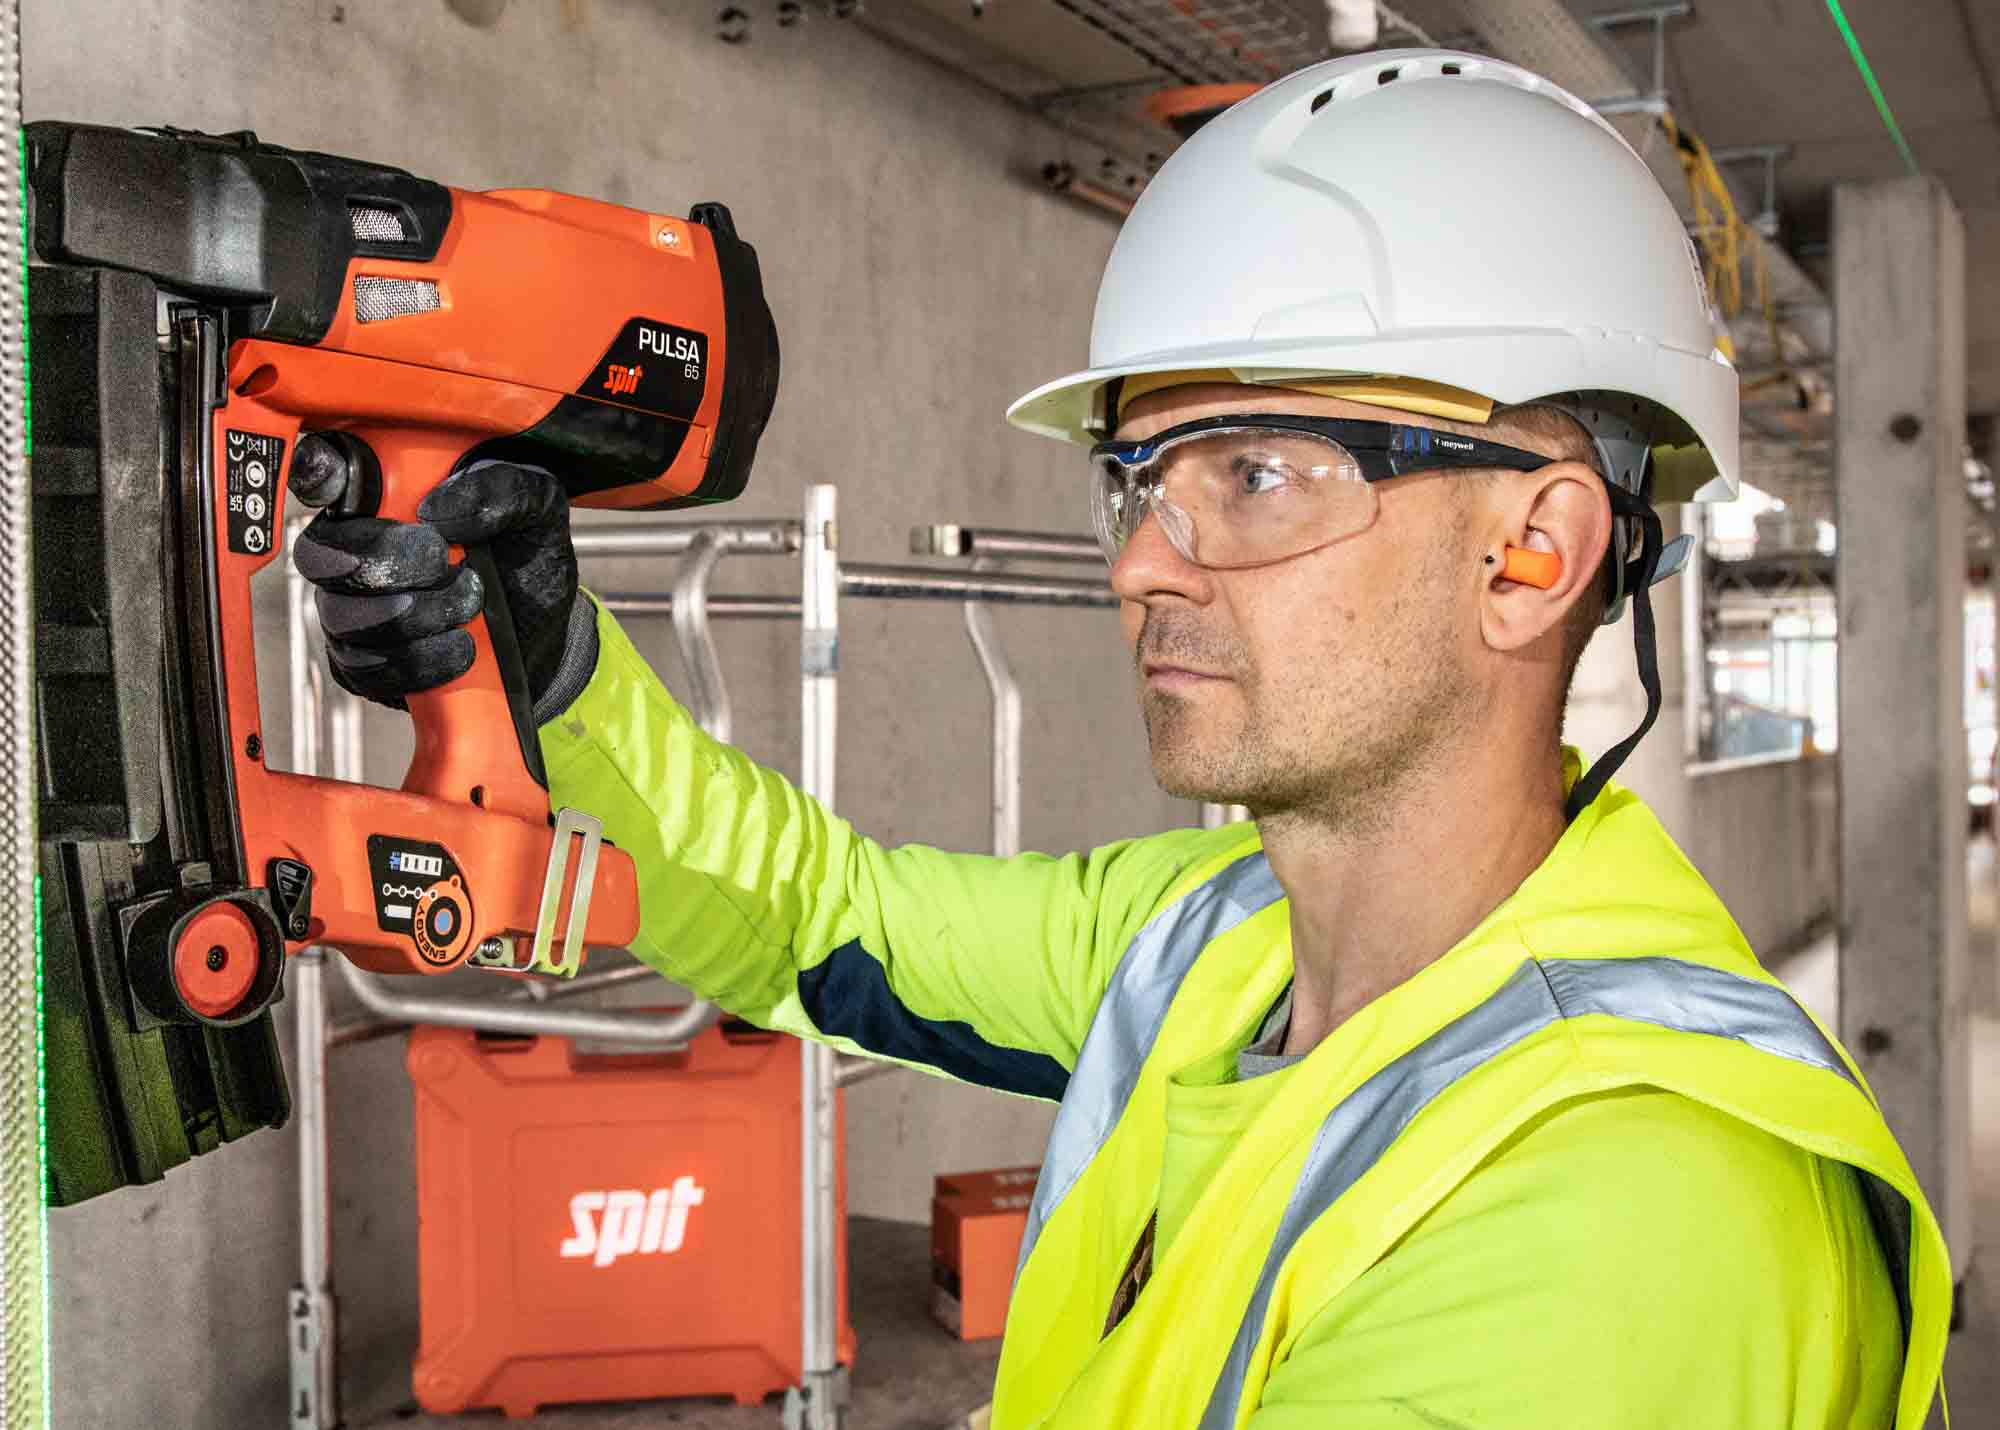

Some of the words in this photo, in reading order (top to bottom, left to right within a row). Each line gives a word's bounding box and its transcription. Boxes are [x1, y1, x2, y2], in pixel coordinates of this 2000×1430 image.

[638, 326, 700, 364] PULSA
[603, 363, 643, 395] spit
[684, 363, 700, 380] 65
[228, 431, 245, 461] CE
[1435, 438, 1474, 450] neywell
[416, 903, 447, 960] ENERGY
[559, 1175, 705, 1267] spit
